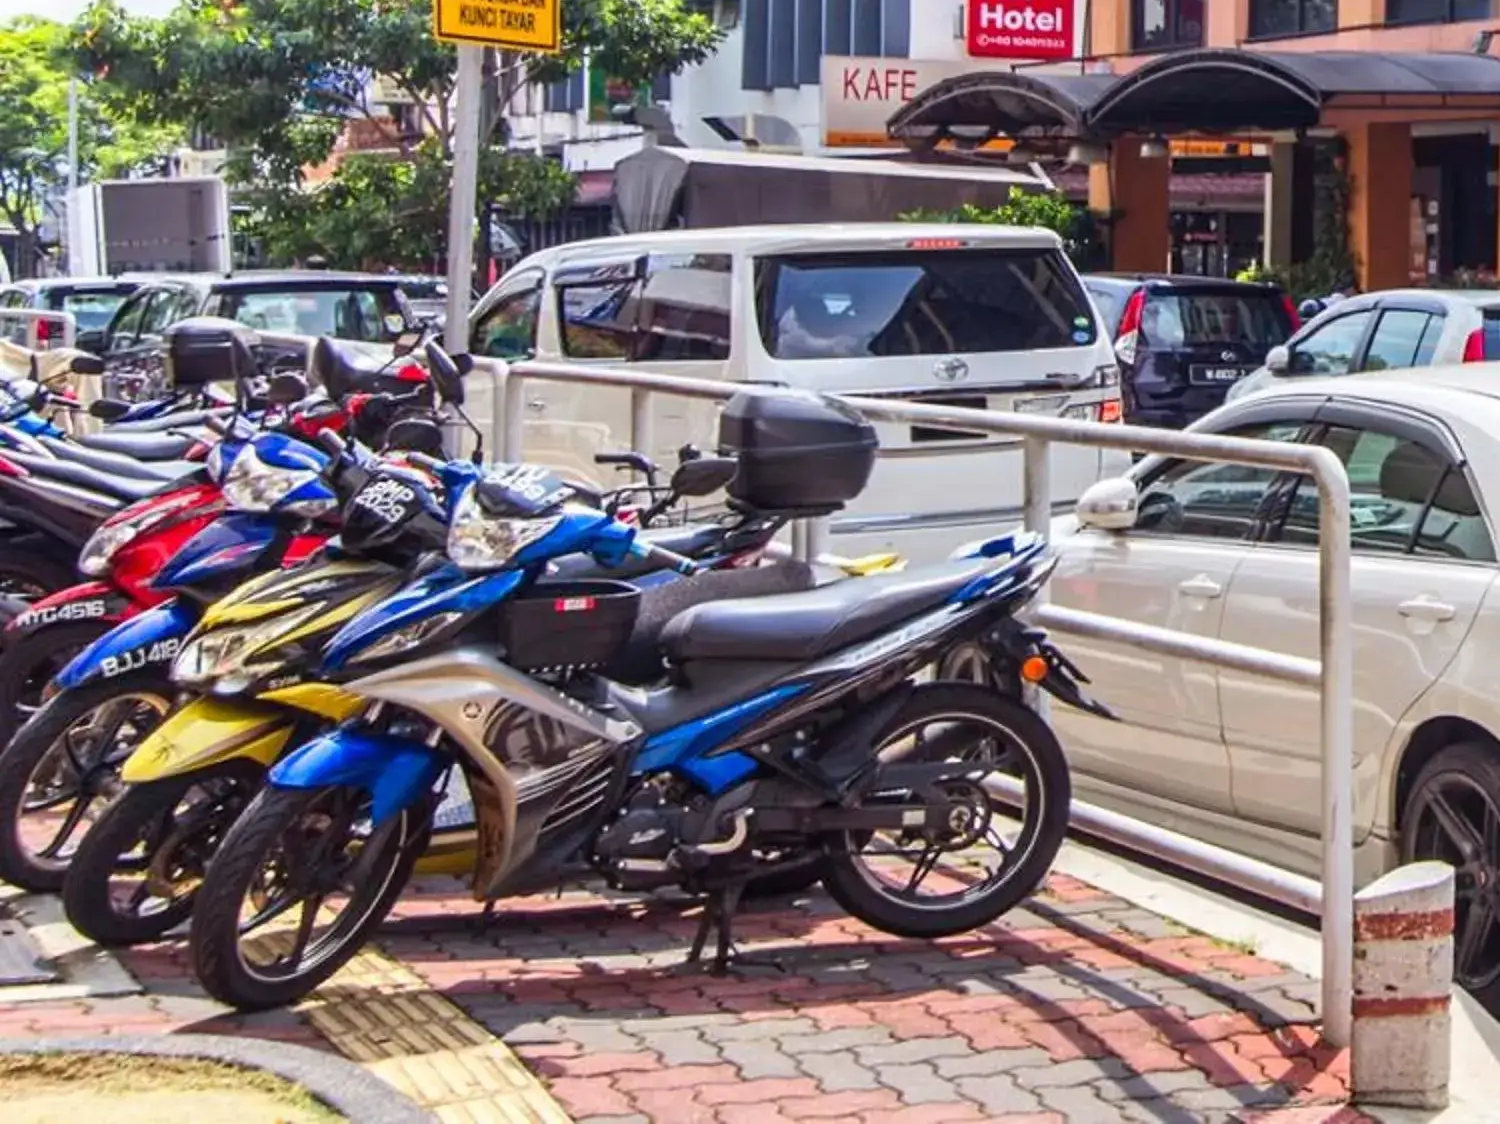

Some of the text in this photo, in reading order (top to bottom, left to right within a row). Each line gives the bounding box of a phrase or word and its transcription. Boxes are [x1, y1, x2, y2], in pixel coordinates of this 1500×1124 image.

[460, 3, 536, 33] KUNCI TAYAR
[980, 2, 1063, 32] Hotel
[843, 68, 917, 102] KAFE
